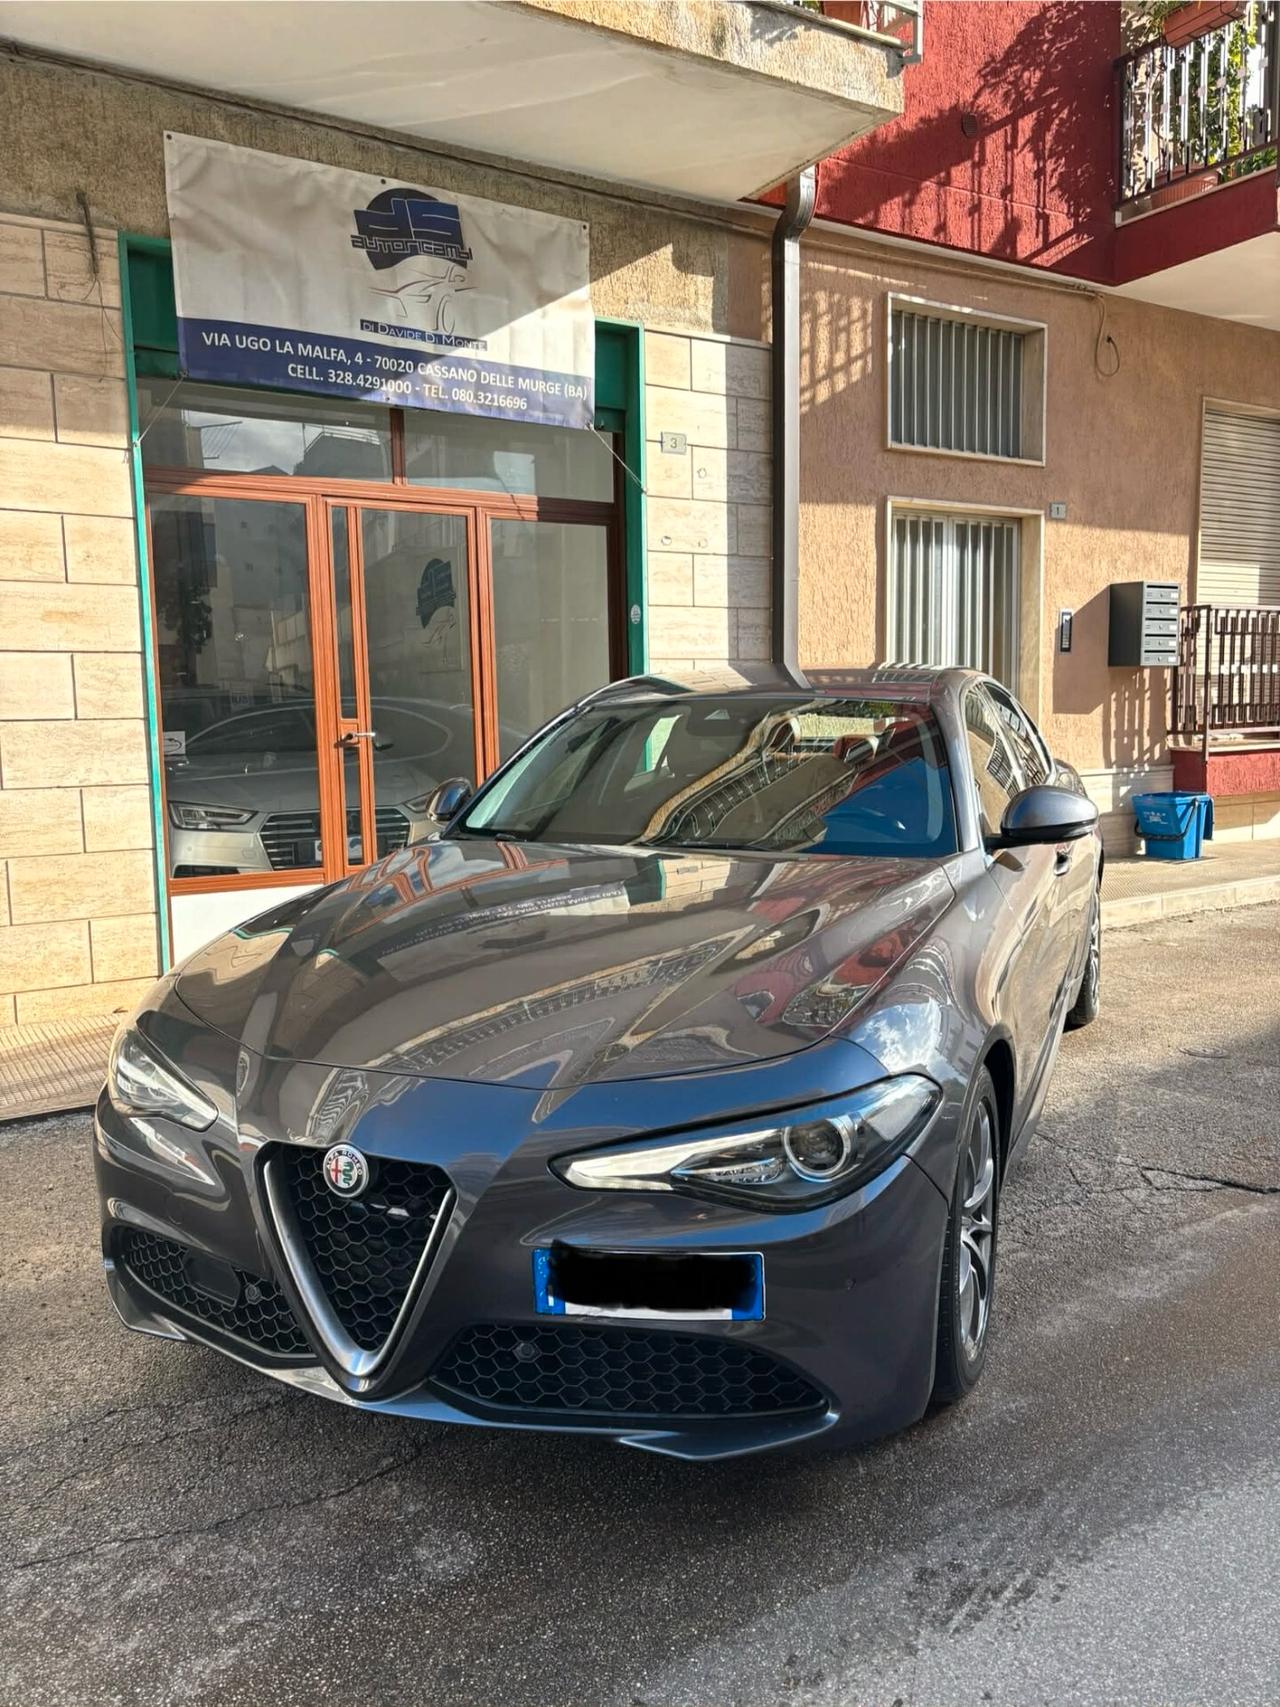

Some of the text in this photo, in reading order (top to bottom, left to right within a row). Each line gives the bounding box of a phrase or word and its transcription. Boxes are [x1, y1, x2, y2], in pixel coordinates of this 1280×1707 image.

[202, 332, 231, 347] VIA
[235, 335, 271, 351] UGO
[275, 341, 294, 355] LA
[298, 343, 351, 364] MALFA,
[354, 351, 364, 365] 4
[374, 355, 414, 373] 70020
[417, 362, 478, 383] CASSANO
[480, 371, 515, 389] DELLE
[518, 377, 561, 395] MURGE
[564, 383, 588, 401] (BA)
[287, 363, 323, 381] CELL.
[327, 369, 412, 393] 328.4291000
[423, 383, 449, 400] TEL.
[451, 387, 528, 411] 080.3216696
[670, 437, 678, 449] 3
